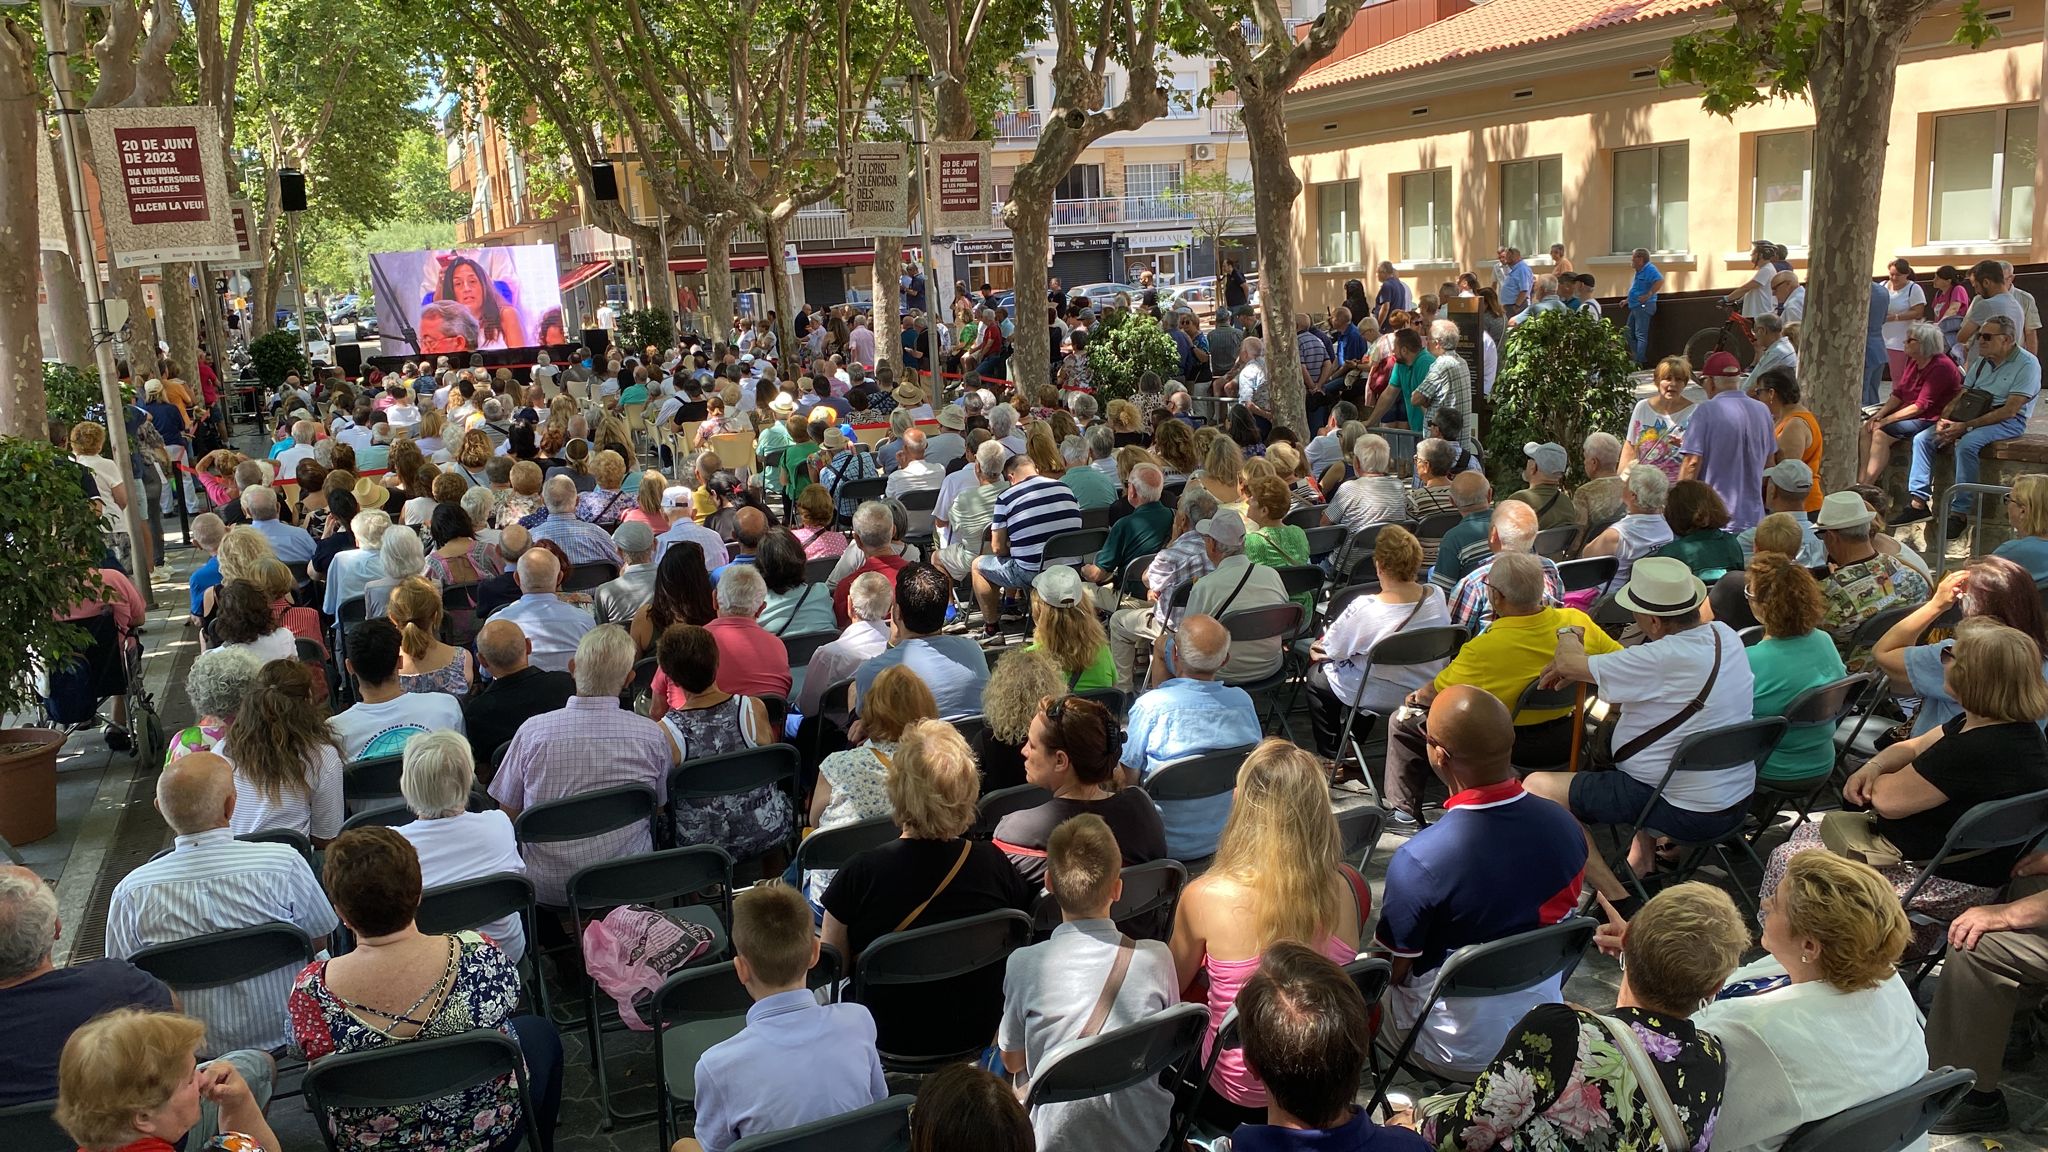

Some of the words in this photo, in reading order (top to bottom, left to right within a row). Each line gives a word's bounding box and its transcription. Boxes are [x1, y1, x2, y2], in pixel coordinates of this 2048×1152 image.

[122, 140, 138, 151] 20
[141, 139, 158, 150] DE
[161, 138, 193, 149] JUNY
[124, 152, 142, 164] DE
[144, 151, 176, 163] 2023
[858, 163, 867, 174] LA
[869, 163, 887, 174] CRISI
[943, 160, 951, 168] 20
[951, 160, 961, 168] DE
[961, 159, 977, 167] JUNY
[127, 168, 142, 176] DIA
[143, 167, 180, 175] MUNDIAL
[951, 167, 968, 175] 2023
[128, 177, 141, 185] DE
[158, 175, 201, 184] PERSONES
[857, 175, 897, 187] SILENCIOSA
[130, 185, 181, 194] REFUGIADES
[857, 188, 874, 199] DELS
[135, 202, 167, 212] ALCEM
[168, 201, 182, 210] LA
[182, 200, 205, 210] VEU!
[856, 200, 895, 212] REFUGIATS
[1089, 238, 1110, 246] TATTOOS
